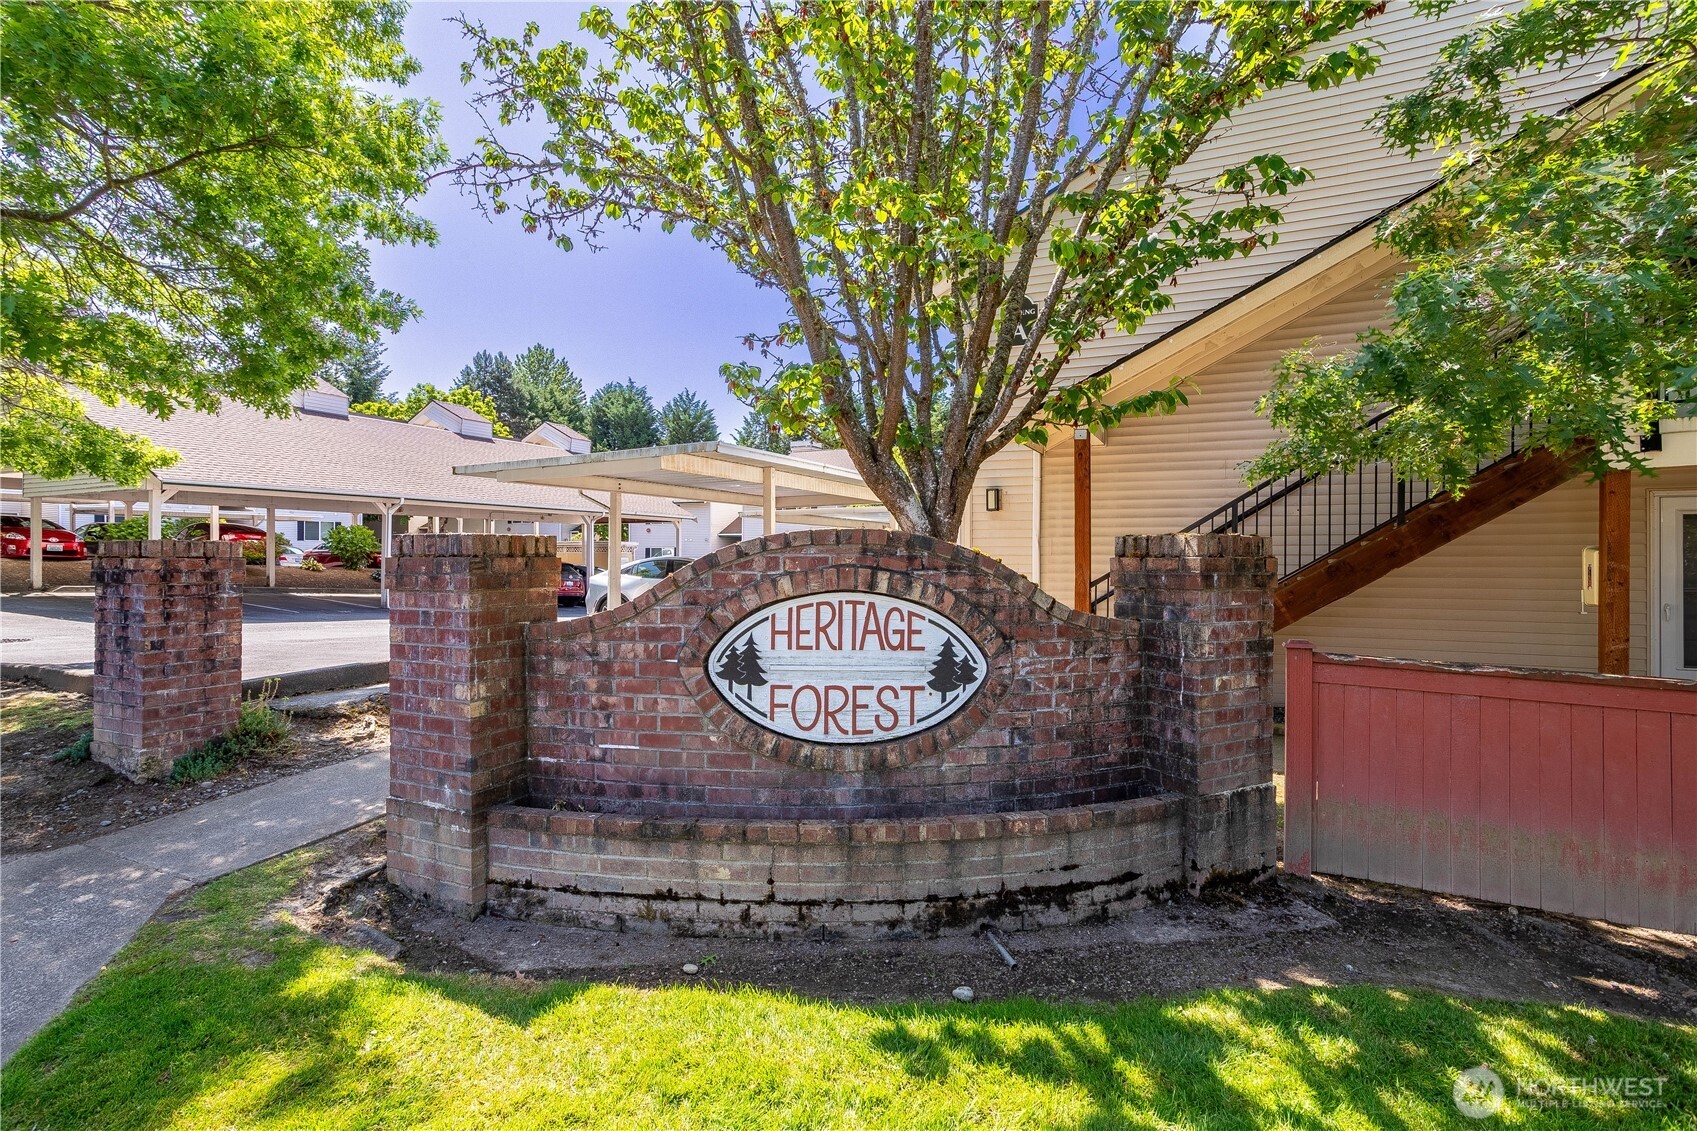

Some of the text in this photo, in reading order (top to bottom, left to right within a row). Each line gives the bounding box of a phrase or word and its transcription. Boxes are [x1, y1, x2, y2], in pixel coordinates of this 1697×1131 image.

[1014, 322, 1028, 340] A
[770, 600, 926, 651] HERITAGE
[769, 684, 926, 735] FOREST
